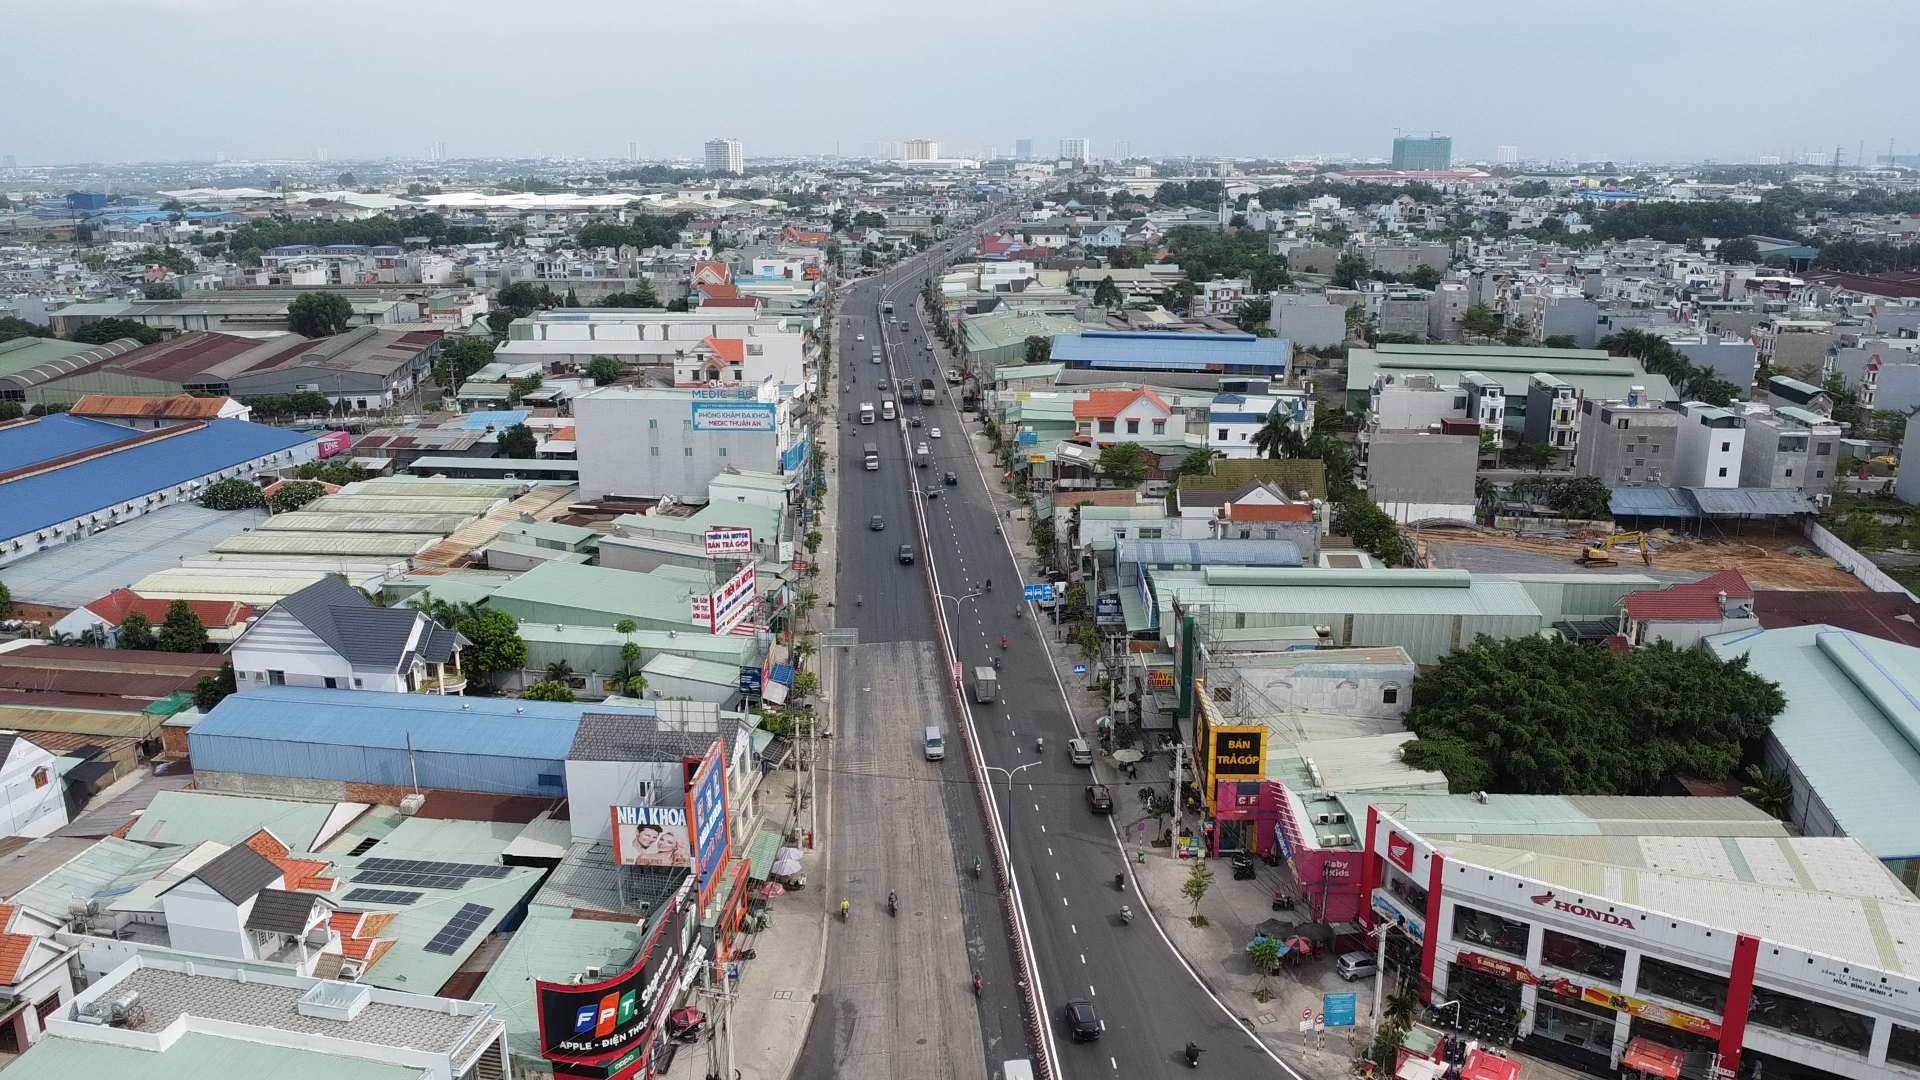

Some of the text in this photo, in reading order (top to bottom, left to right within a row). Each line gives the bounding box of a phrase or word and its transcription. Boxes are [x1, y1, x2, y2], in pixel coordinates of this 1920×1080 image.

[692, 390, 728, 399] MEDIC
[737, 390, 754, 399] BD
[698, 411, 721, 419] PHÒNG
[324, 441, 339, 451] ONE
[707, 541, 721, 549] BÁN
[1228, 738, 1251, 749] BÁN
[1216, 752, 1260, 765] TRẢ GÓP
[616, 806, 687, 826] NHA KHOA
[1553, 900, 1636, 930] HONDA
[1833, 977, 1848, 986] HÒA
[1850, 983, 1867, 991] BÌNH
[1869, 987, 1886, 996] MINH
[560, 1040, 593, 1051] APPLE
[602, 1033, 627, 1048] ĐIỆN
[614, 1054, 634, 1070] oppo
